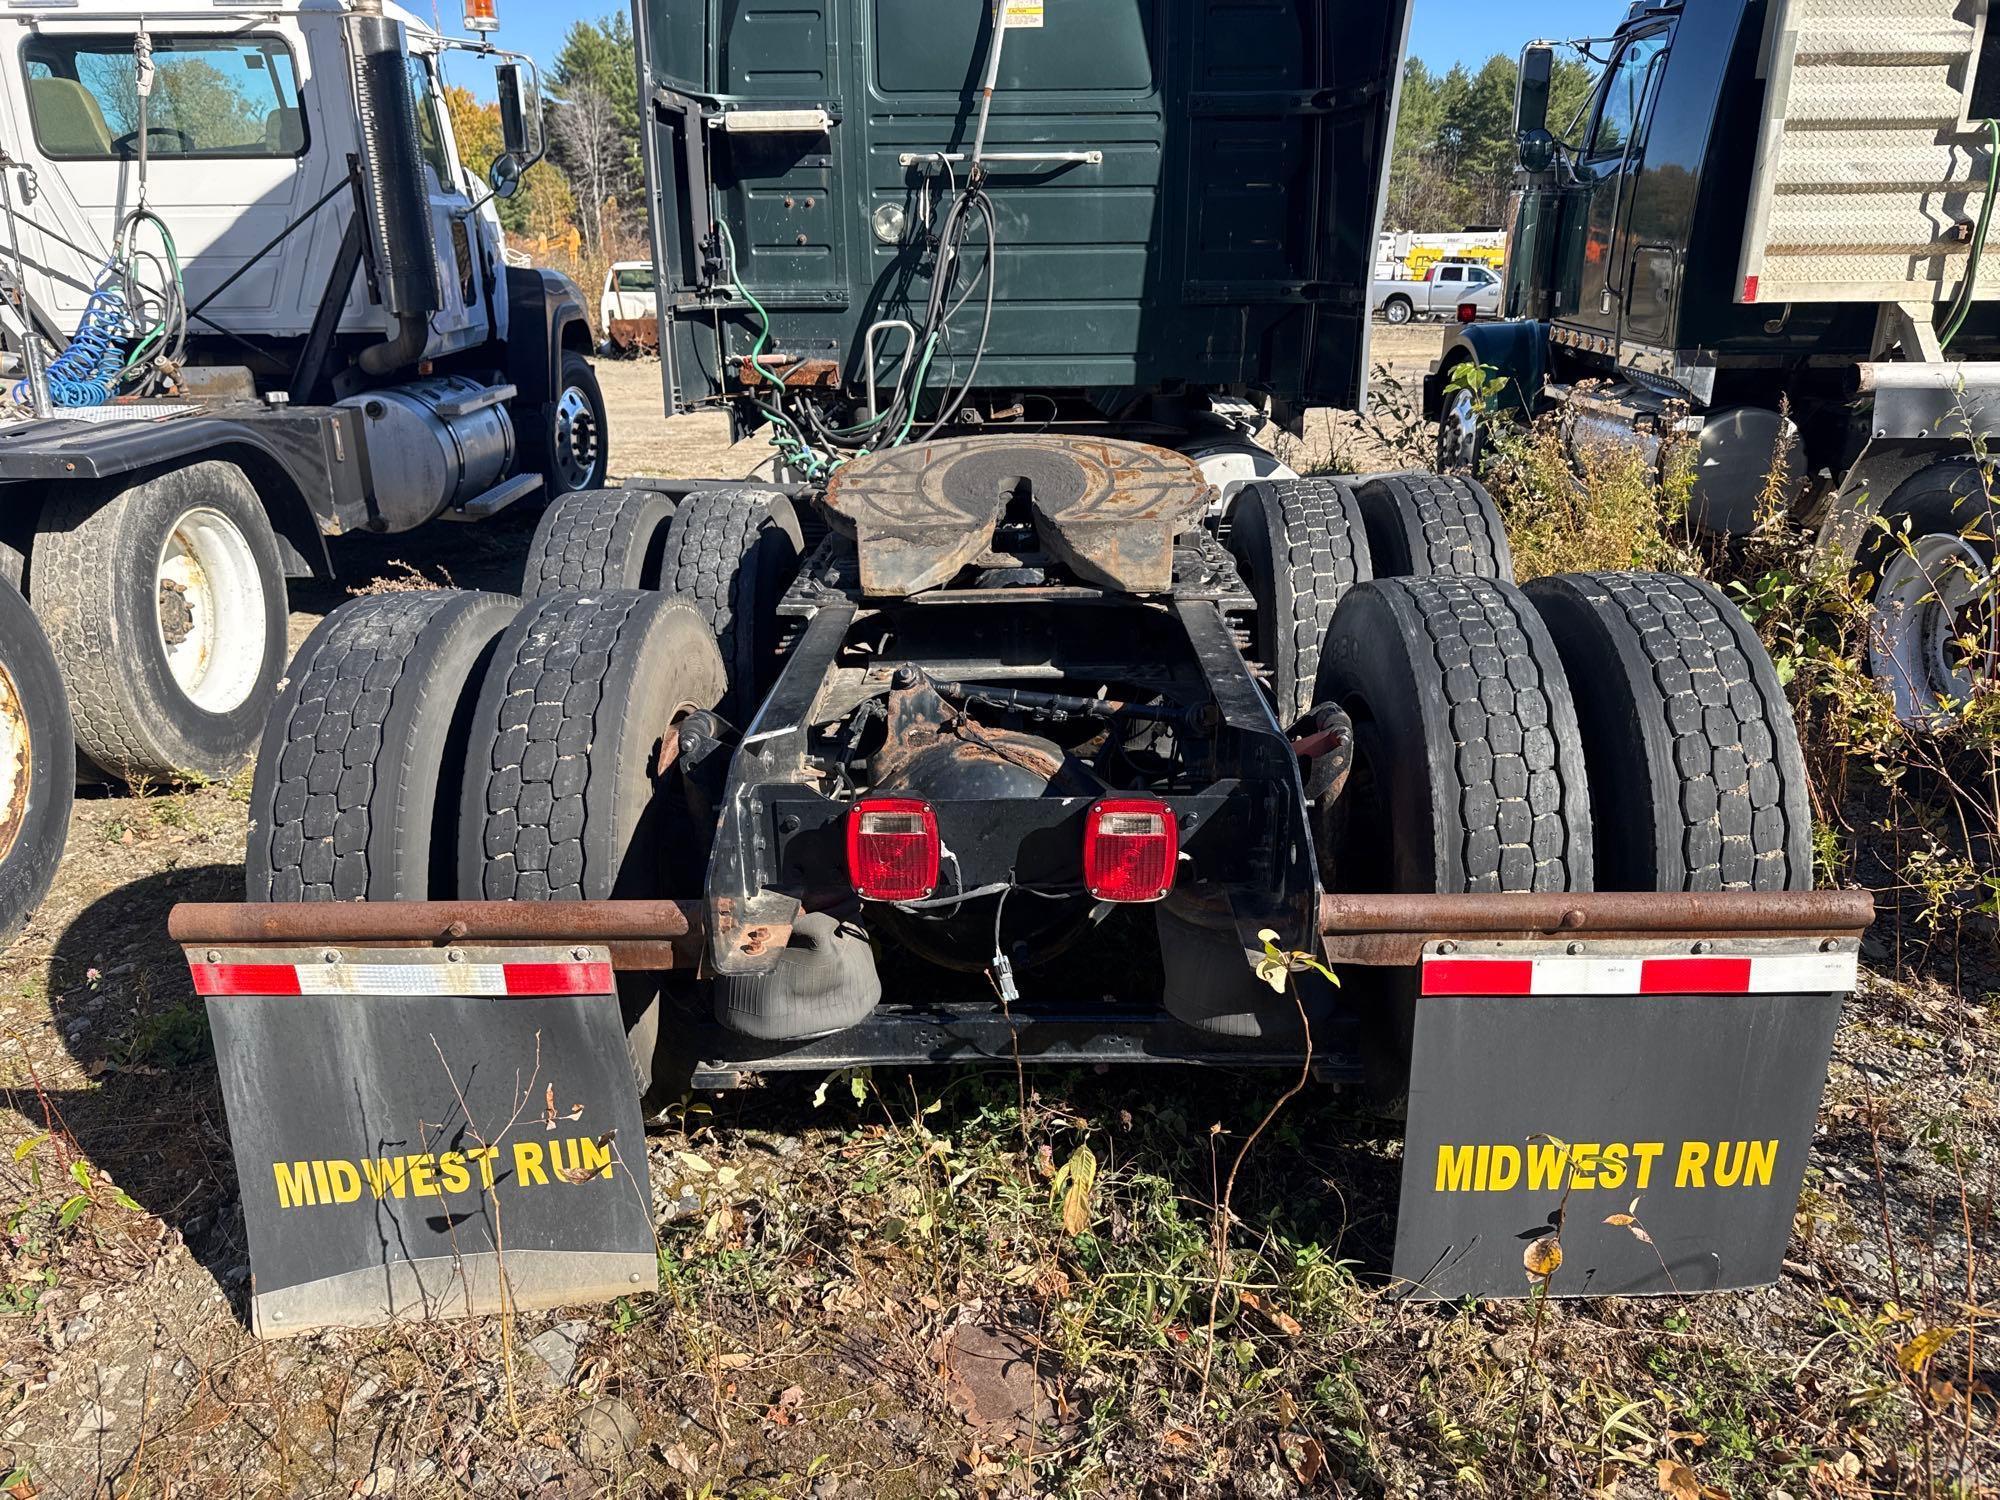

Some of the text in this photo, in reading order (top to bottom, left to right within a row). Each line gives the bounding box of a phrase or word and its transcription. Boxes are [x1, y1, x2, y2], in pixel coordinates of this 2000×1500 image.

[273, 1137, 613, 1208] MIDWEST RUN
[1435, 1140, 1779, 1191] MIDWEST RUN
